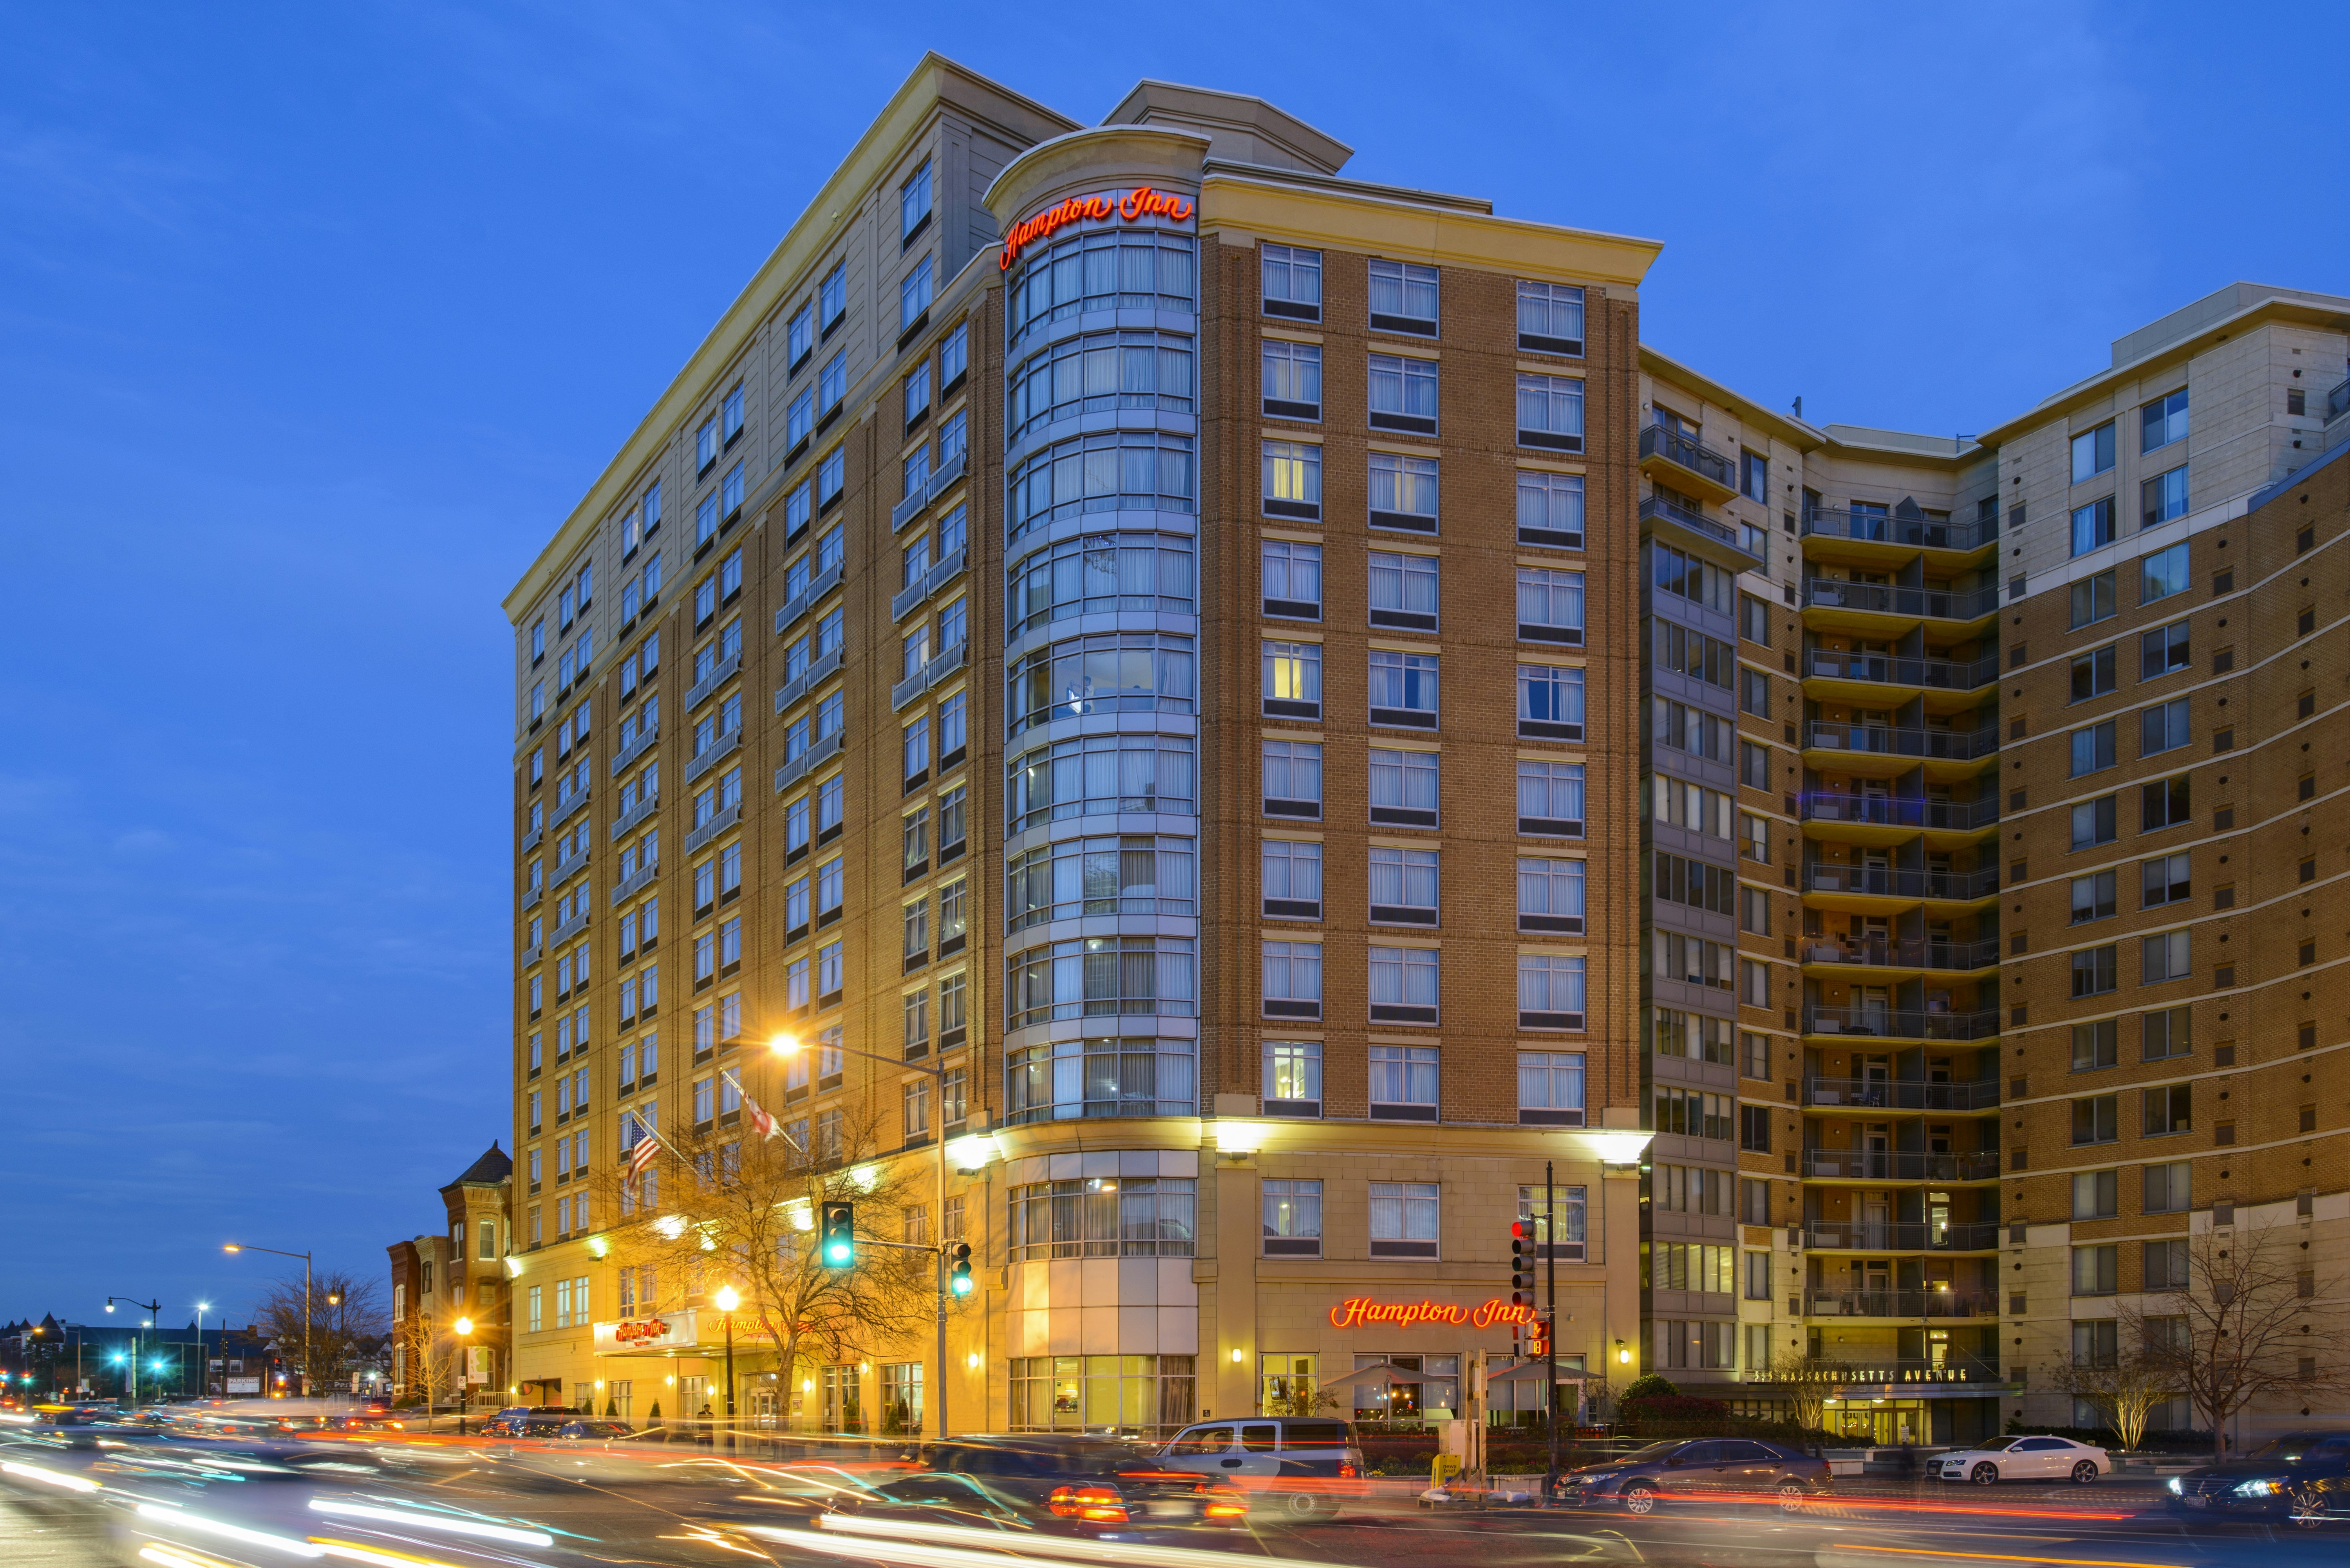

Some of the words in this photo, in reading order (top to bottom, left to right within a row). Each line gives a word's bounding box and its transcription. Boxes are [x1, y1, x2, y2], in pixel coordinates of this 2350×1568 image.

[1000, 197, 1113, 270] Hampton
[1119, 186, 1192, 219] Inn
[1330, 1297, 1469, 1327] Hampton
[1472, 1299, 1536, 1328] Inn
[616, 1322, 646, 1342] Hampton
[647, 1319, 667, 1338] Inn
[1533, 1340, 1542, 1354] 18
[1905, 1369, 1966, 1380] AVENUE
